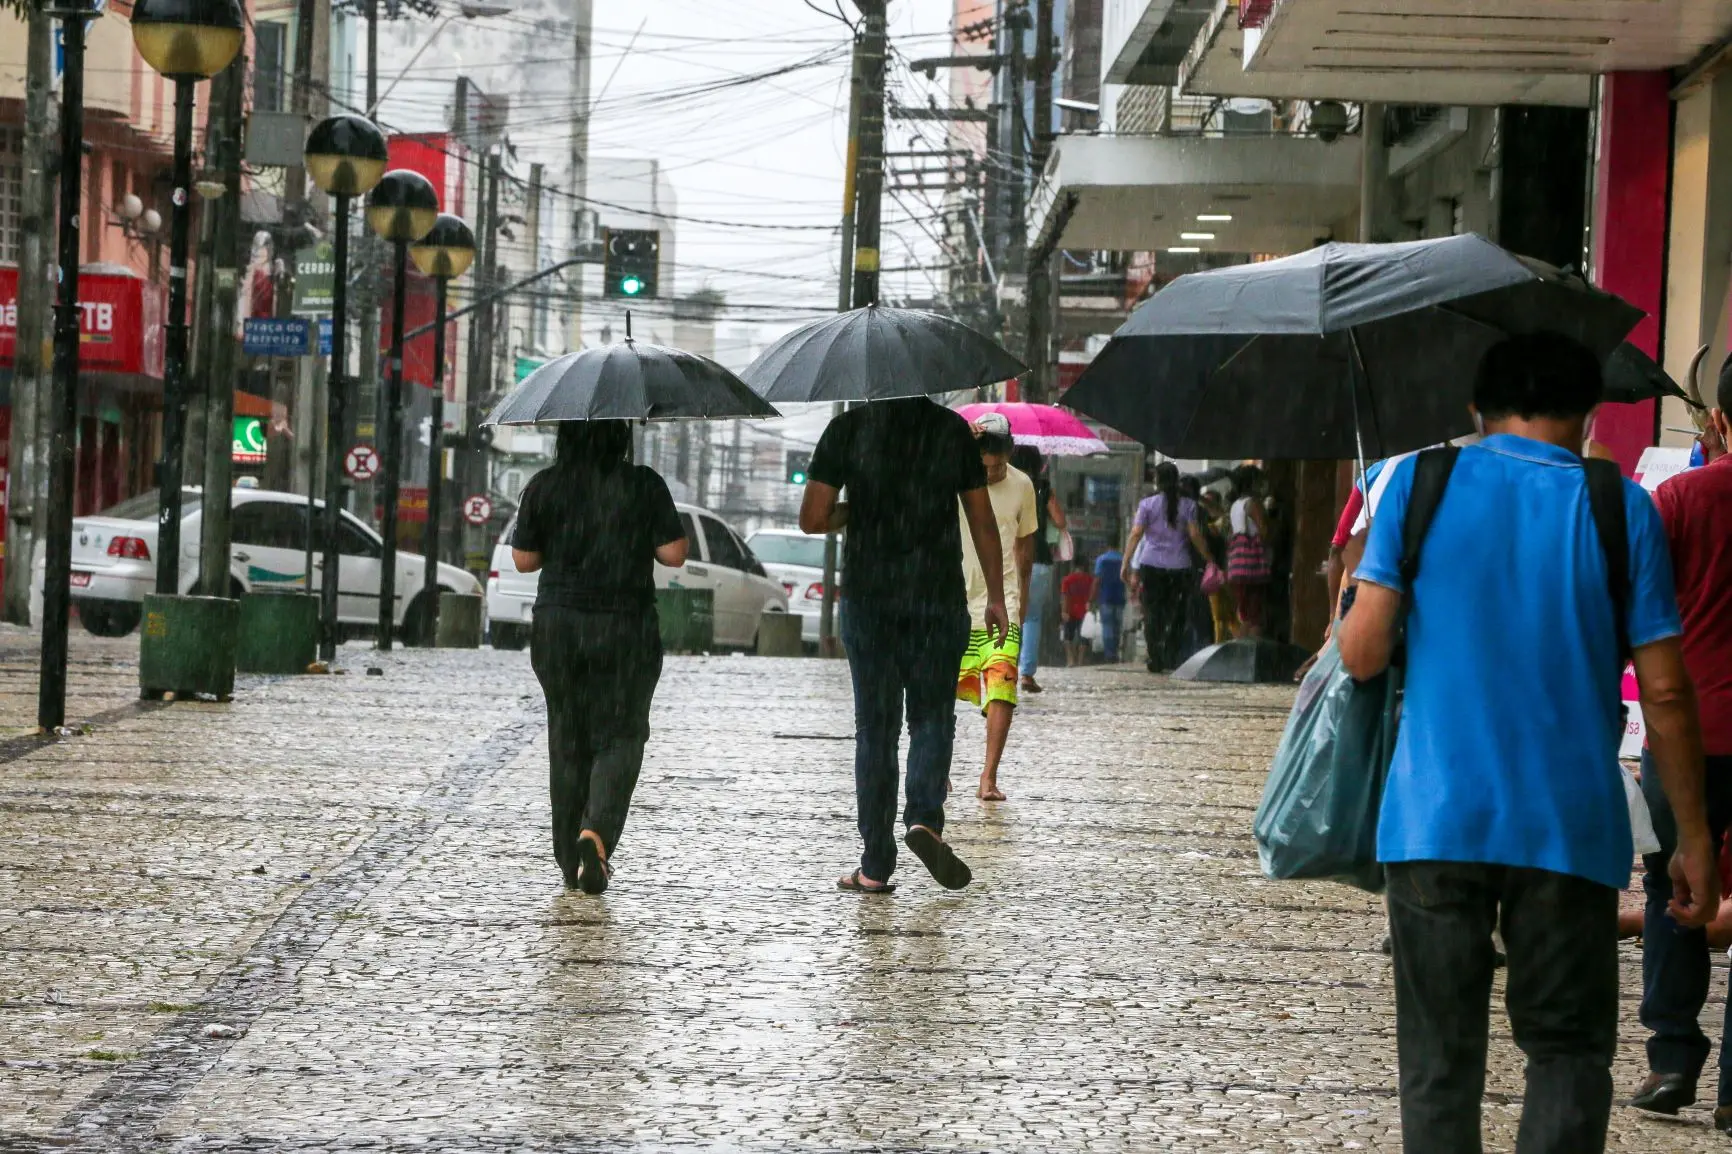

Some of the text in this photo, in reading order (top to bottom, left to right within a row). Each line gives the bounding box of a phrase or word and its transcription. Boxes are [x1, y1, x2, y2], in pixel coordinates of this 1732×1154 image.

[245, 322, 304, 333] Praça do
[244, 334, 300, 345] Ferreira
